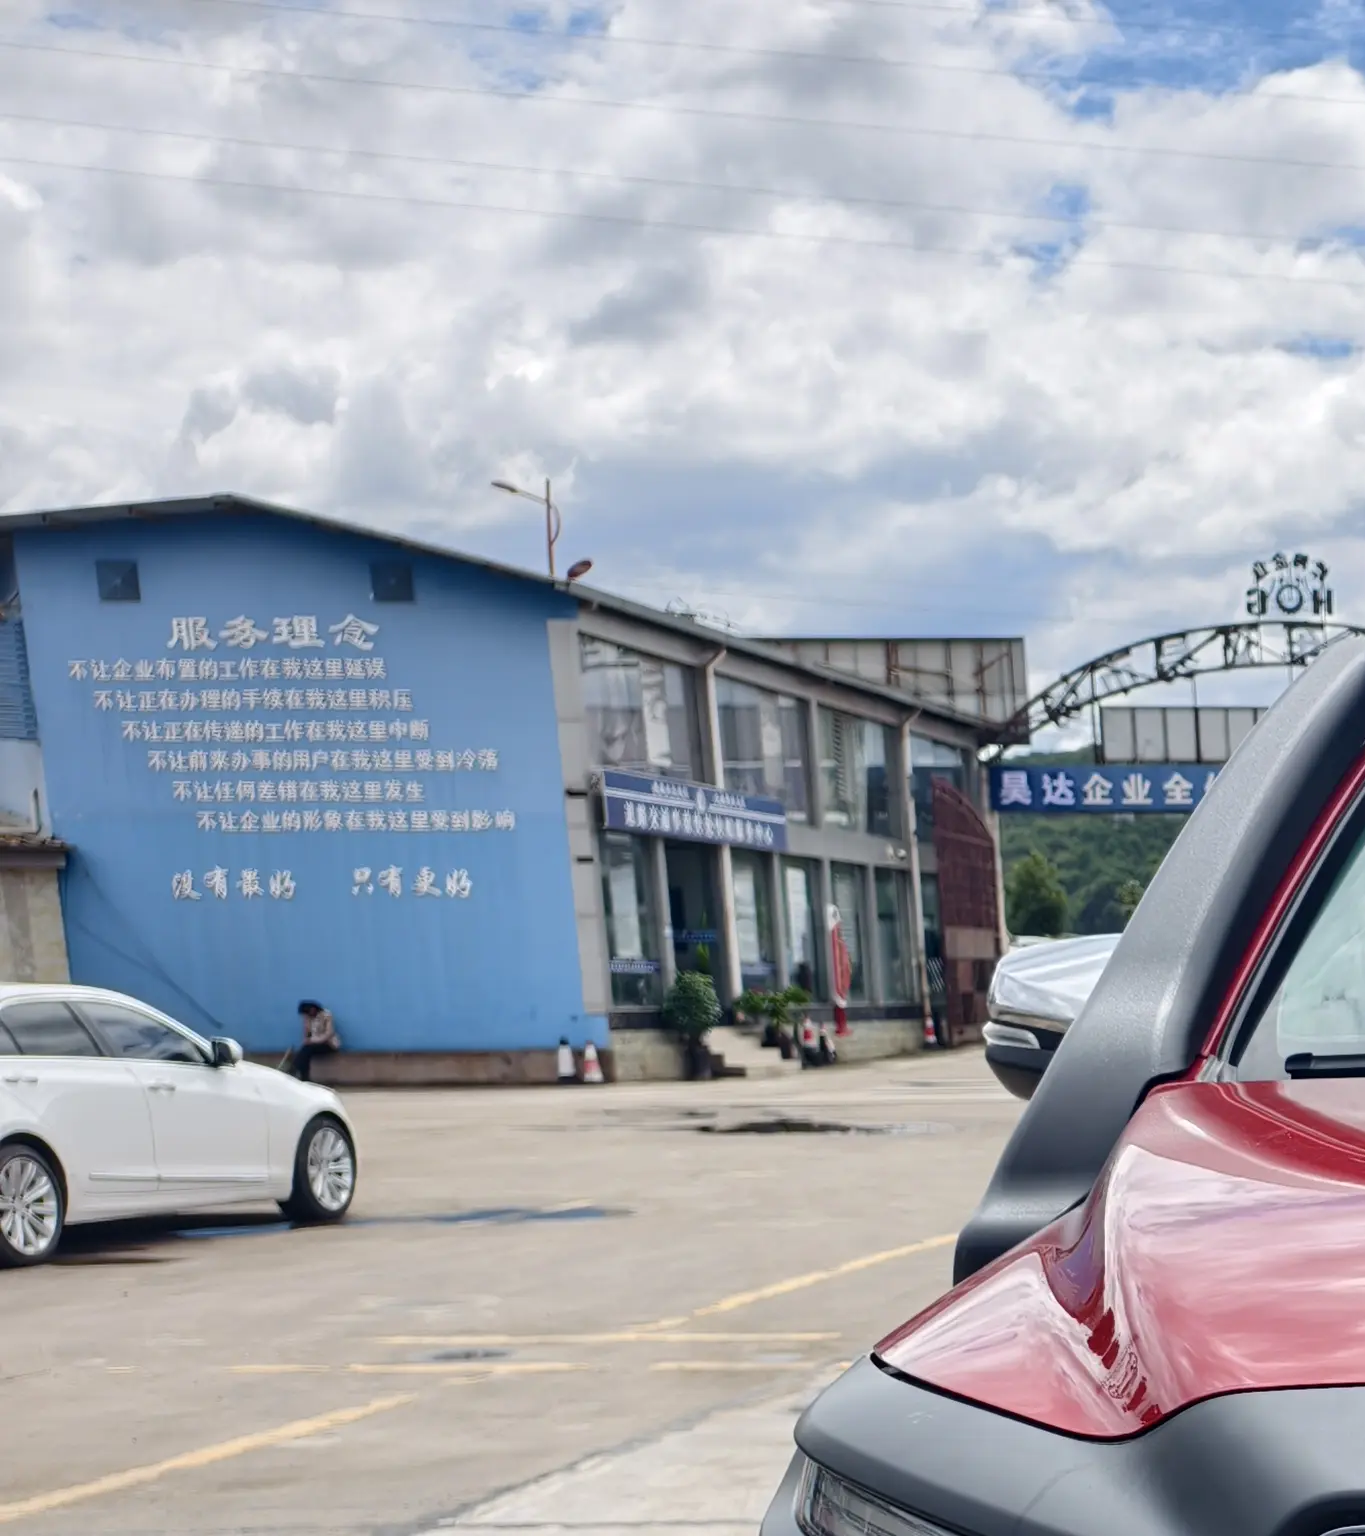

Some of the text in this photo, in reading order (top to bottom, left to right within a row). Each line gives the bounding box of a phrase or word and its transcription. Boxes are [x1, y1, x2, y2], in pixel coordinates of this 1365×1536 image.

[166, 613, 380, 651] 服务理念
[68, 657, 387, 681] 不让企业布置的工作在我这里延误
[94, 688, 413, 711] 不让正在办理的手续在我这里积压
[121, 719, 429, 742] 不让正在传递的工作在我这里中断
[148, 749, 498, 772] 不让前来办事的用户在我这里受到冷落
[172, 779, 425, 802] 不让任何差错在我这里发生
[196, 809, 516, 832] 不让企业的形象在我这里受到影响
